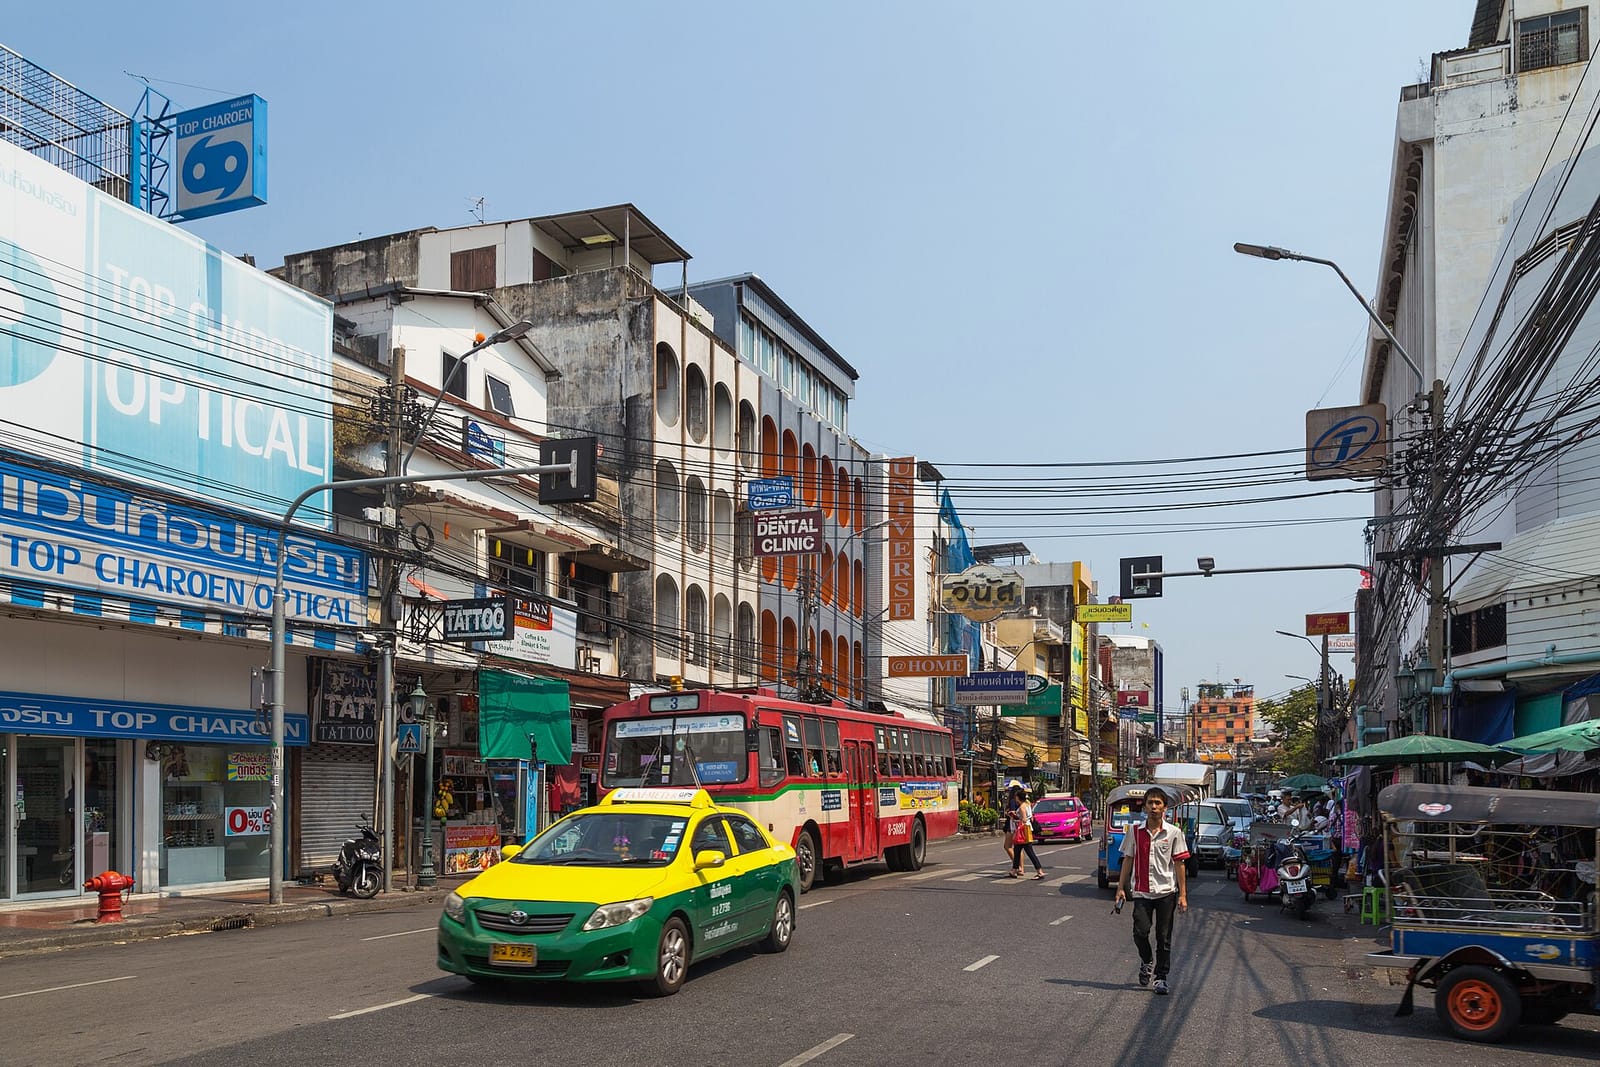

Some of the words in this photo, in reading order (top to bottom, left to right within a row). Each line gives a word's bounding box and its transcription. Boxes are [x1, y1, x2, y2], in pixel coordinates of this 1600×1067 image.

[178, 121, 199, 137] TOP
[202, 108, 253, 130] CHAROEN
[106, 263, 175, 324] TOP
[189, 302, 323, 395] CHAROEN
[104, 352, 324, 477] OPTICAL
[757, 518, 819, 536] DENTAL
[893, 458, 911, 618] UNIVERSE
[761, 536, 815, 553] CLINIC
[3, 533, 82, 576] TOP
[95, 552, 245, 607] CHAROEN
[445, 608, 505, 631] TATTOO
[891, 658, 964, 673] @HOME
[670, 697, 678, 710] 3
[89, 709, 157, 730] TOP
[169, 715, 300, 738] CHARON
[320, 726, 374, 740] TATTOO
